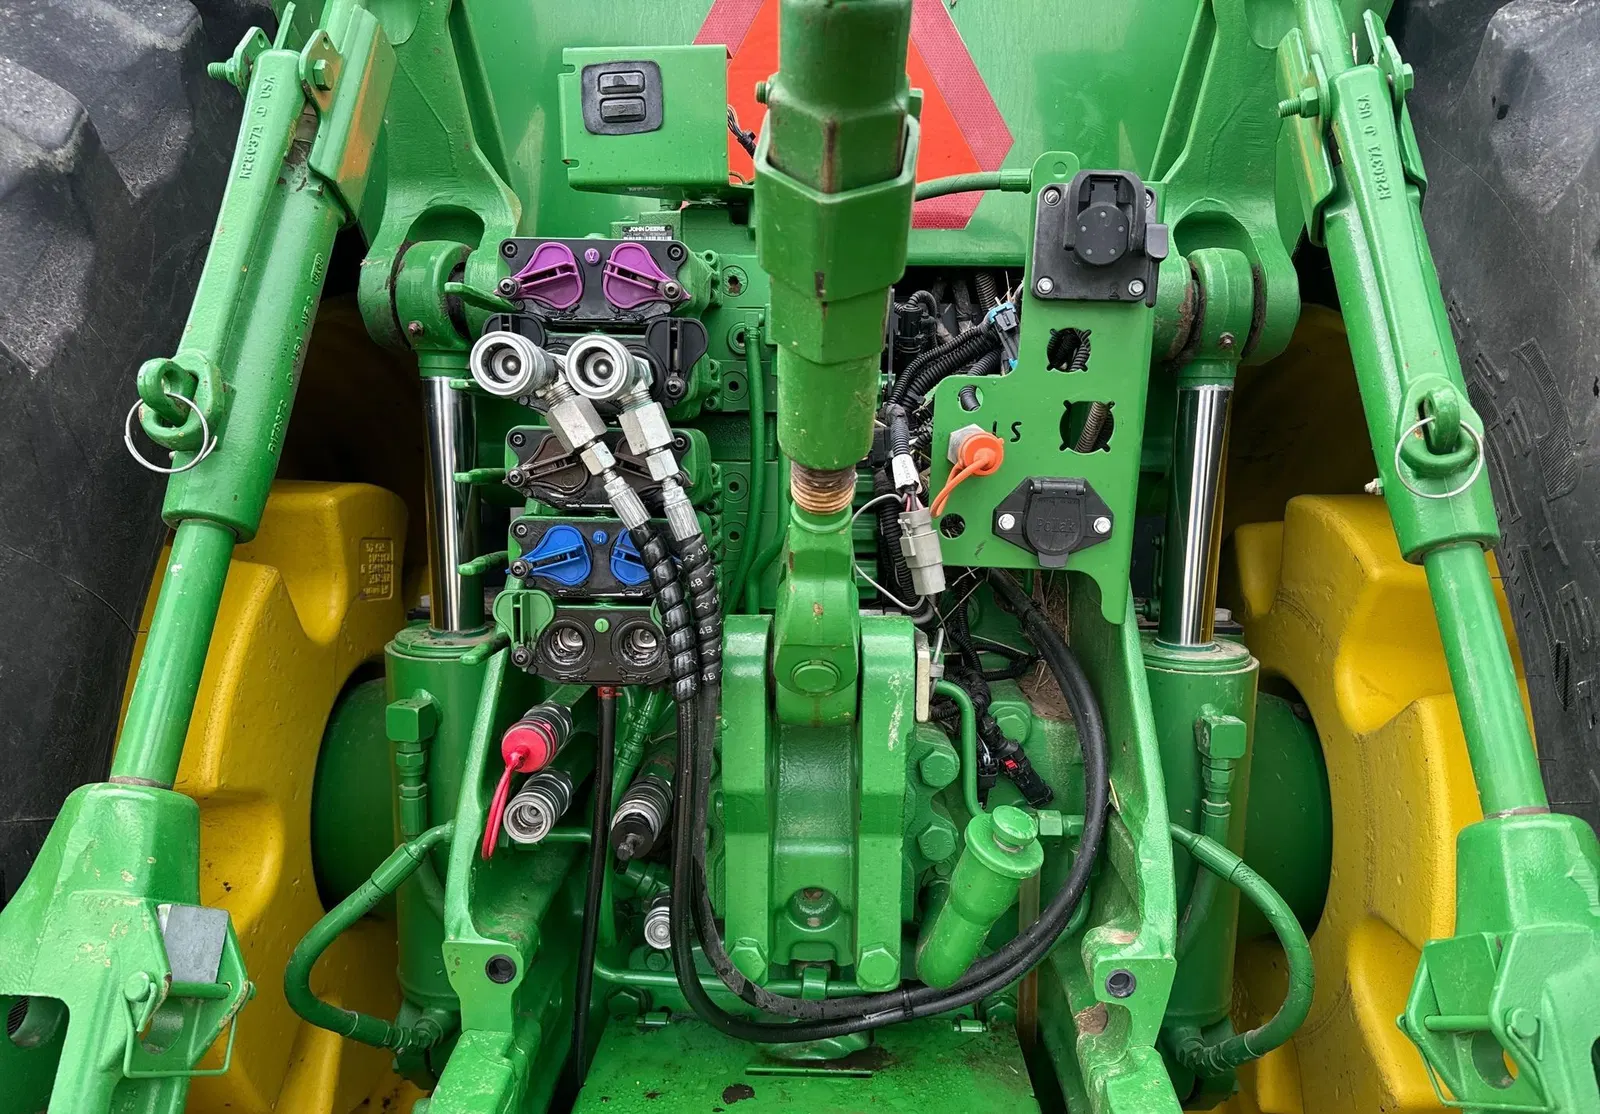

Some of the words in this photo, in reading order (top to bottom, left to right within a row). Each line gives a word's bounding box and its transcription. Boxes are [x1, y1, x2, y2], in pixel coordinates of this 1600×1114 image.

[260, 76, 276, 100] USA
[1357, 93, 1372, 120] USA
[1368, 143, 1392, 201] R280371
[690, 577, 703, 589] 4B
[699, 624, 713, 636] 4B
[702, 671, 716, 682] 4B
